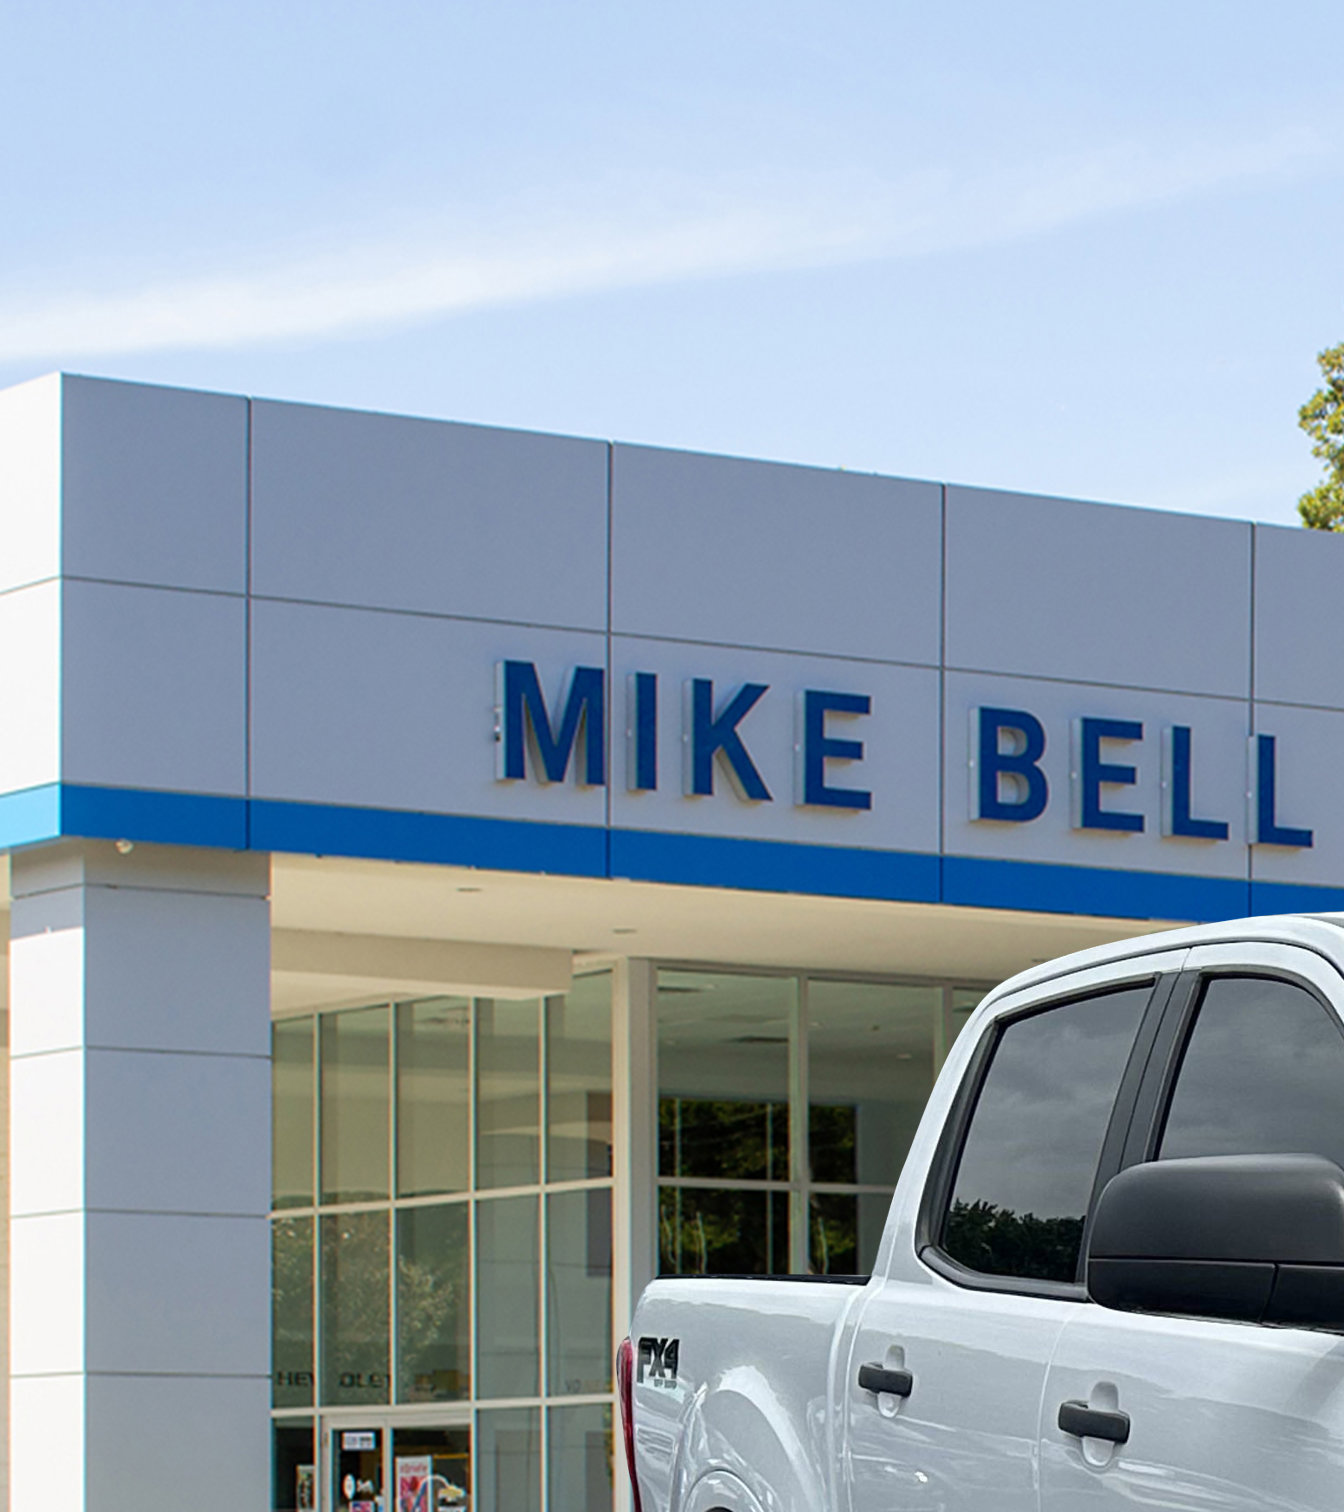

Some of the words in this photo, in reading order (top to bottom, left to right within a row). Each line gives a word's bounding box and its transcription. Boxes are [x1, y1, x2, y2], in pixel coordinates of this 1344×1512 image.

[496, 660, 873, 811] MIKE
[968, 706, 1313, 848] BELL
[637, 1336, 680, 1383] FX4
